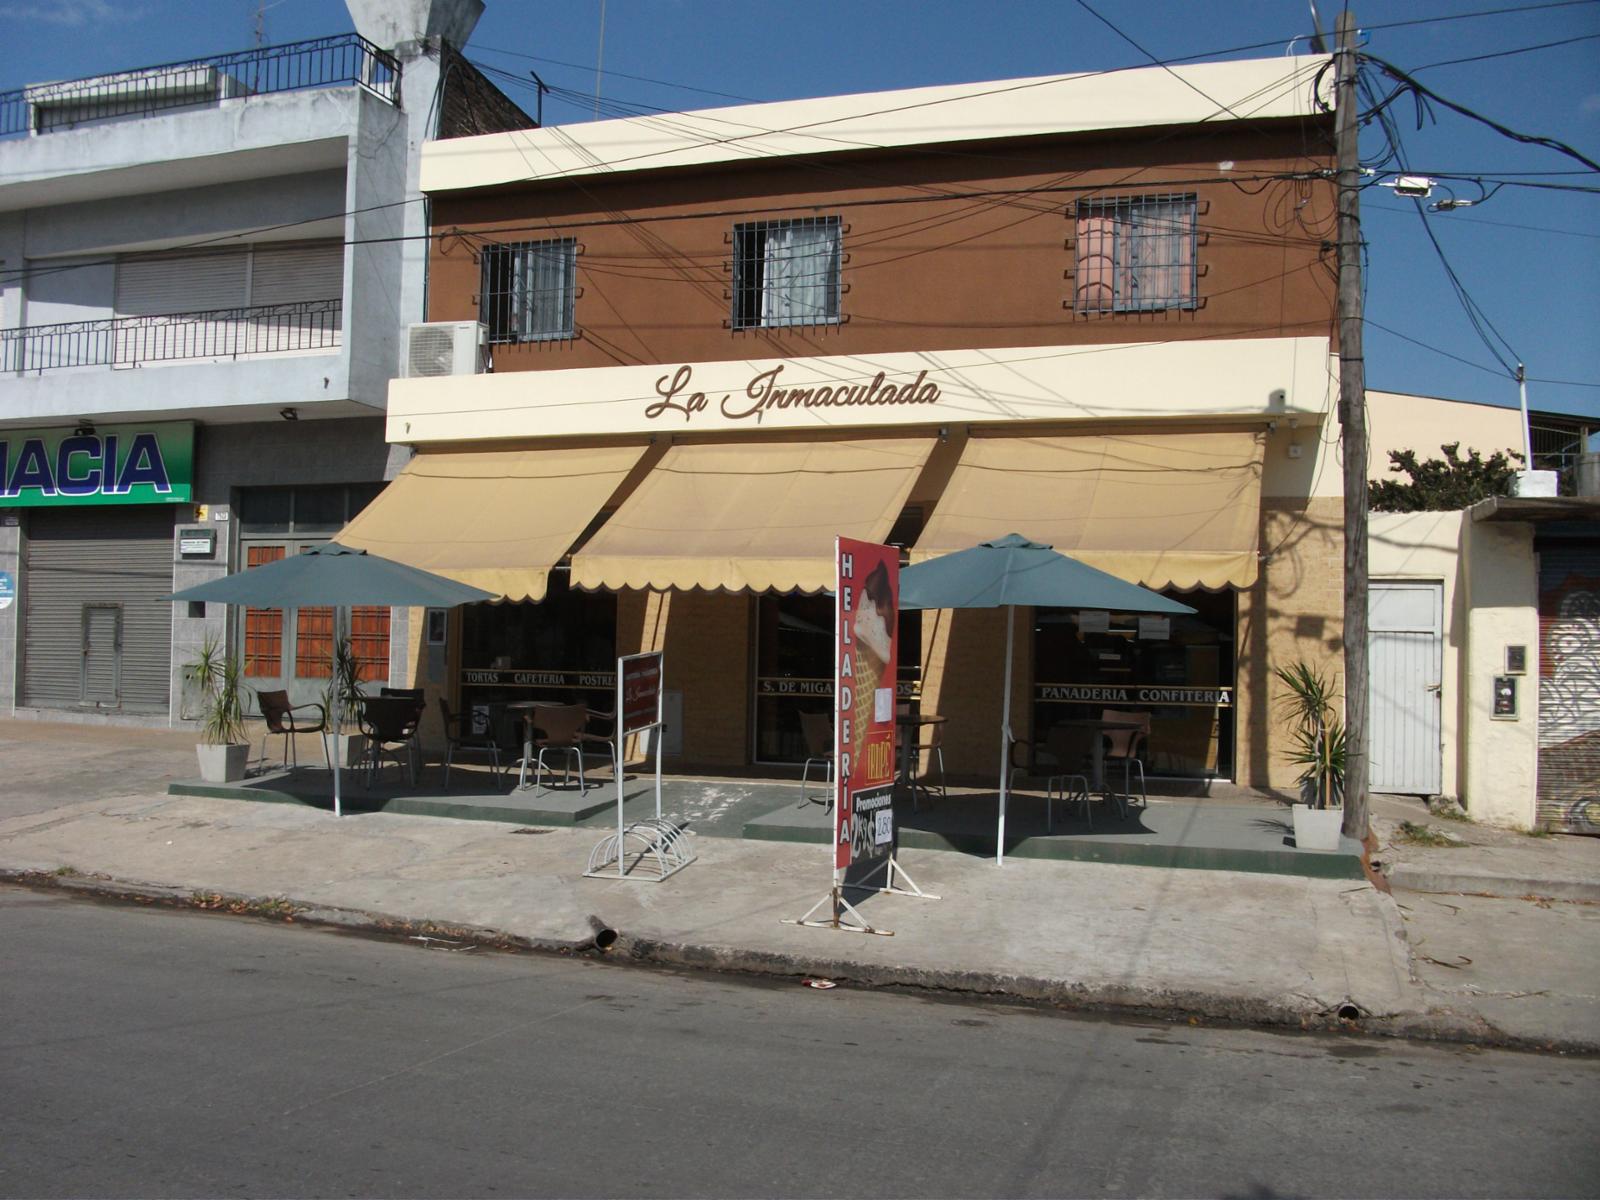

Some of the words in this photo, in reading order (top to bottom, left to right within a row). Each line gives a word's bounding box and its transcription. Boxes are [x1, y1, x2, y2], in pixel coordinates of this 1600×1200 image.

[645, 365, 708, 422] La
[720, 364, 941, 424] Inmaculada
[466, 672, 499, 683] TORTAS
[514, 673, 565, 685] CAFETERIA
[779, 681, 796, 693] DE
[800, 682, 833, 694] MIGA
[1041, 687, 1128, 701] PANADERIA
[1139, 689, 1230, 703] CONFITERIA
[856, 794, 891, 812] Promociones
